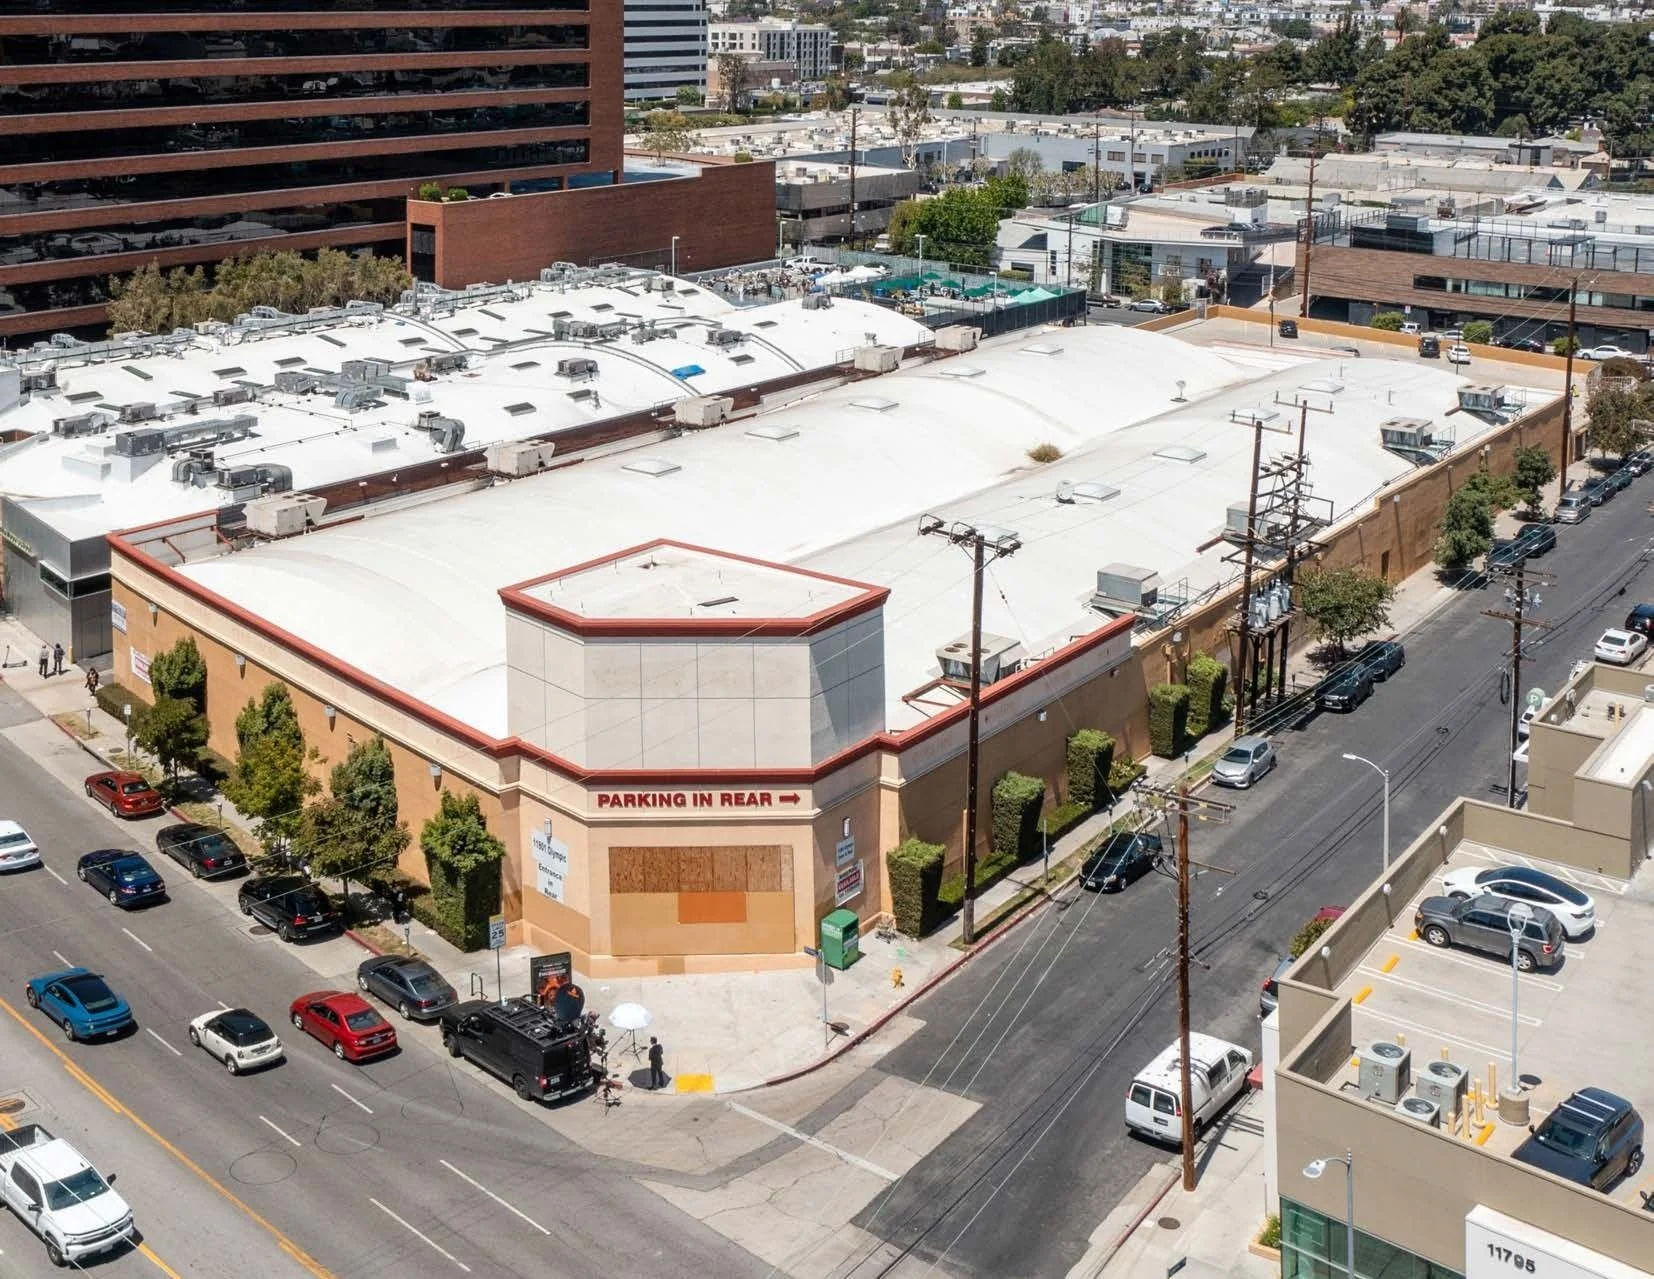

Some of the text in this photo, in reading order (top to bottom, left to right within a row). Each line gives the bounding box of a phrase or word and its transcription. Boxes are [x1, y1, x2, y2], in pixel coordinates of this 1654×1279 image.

[597, 792, 772, 808] PARKING IN REAR
[547, 845, 567, 863] Olympic
[538, 863, 562, 880] Entrance
[544, 887, 558, 899] Rear
[492, 929, 504, 940] 25
[1487, 1243, 1536, 1274] 11795
